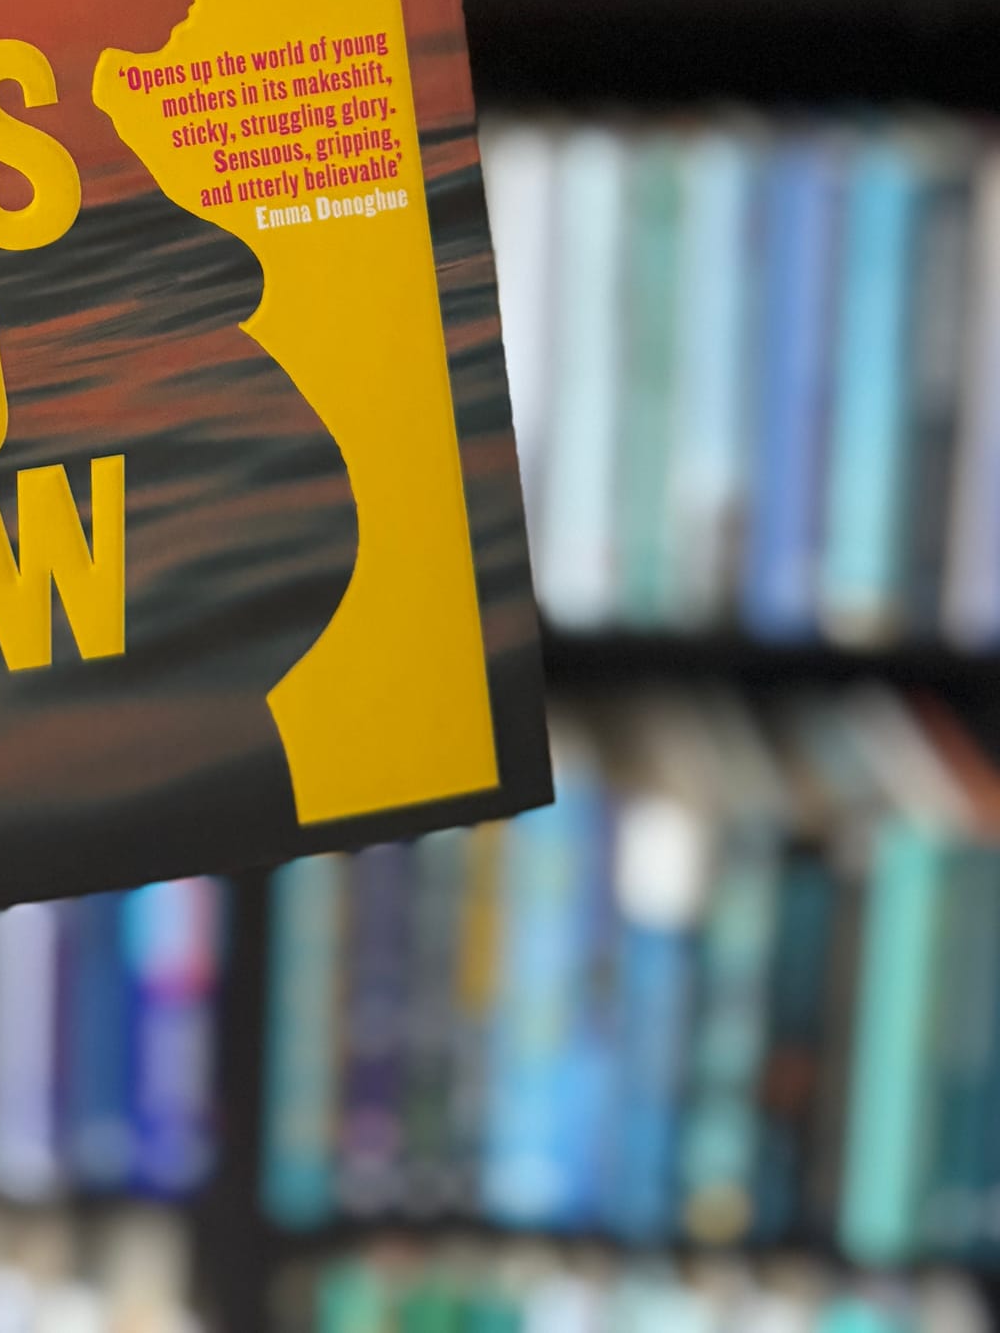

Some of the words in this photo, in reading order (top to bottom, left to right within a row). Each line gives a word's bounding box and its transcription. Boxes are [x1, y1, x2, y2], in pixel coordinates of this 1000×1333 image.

[190, 59, 212, 84] up
[217, 51, 246, 76] the
[251, 41, 304, 71] world
[309, 36, 327, 62] of
[332, 32, 389, 64] young
[162, 88, 237, 118] mothers
[241, 80, 258, 104] in
[263, 77, 288, 100] its
[293, 61, 393, 97] makeshift,
[172, 120, 236, 148] sticky,
[241, 104, 336, 138] struggling
[342, 95, 397, 125] glory.
[213, 141, 311, 173] Sensuous,
[316, 127, 401, 161] gripping,
[200, 181, 233, 207] and
[237, 173, 299, 203] utterly
[255, 205, 312, 230] Emma
[315, 187, 408, 221] Donoghue
